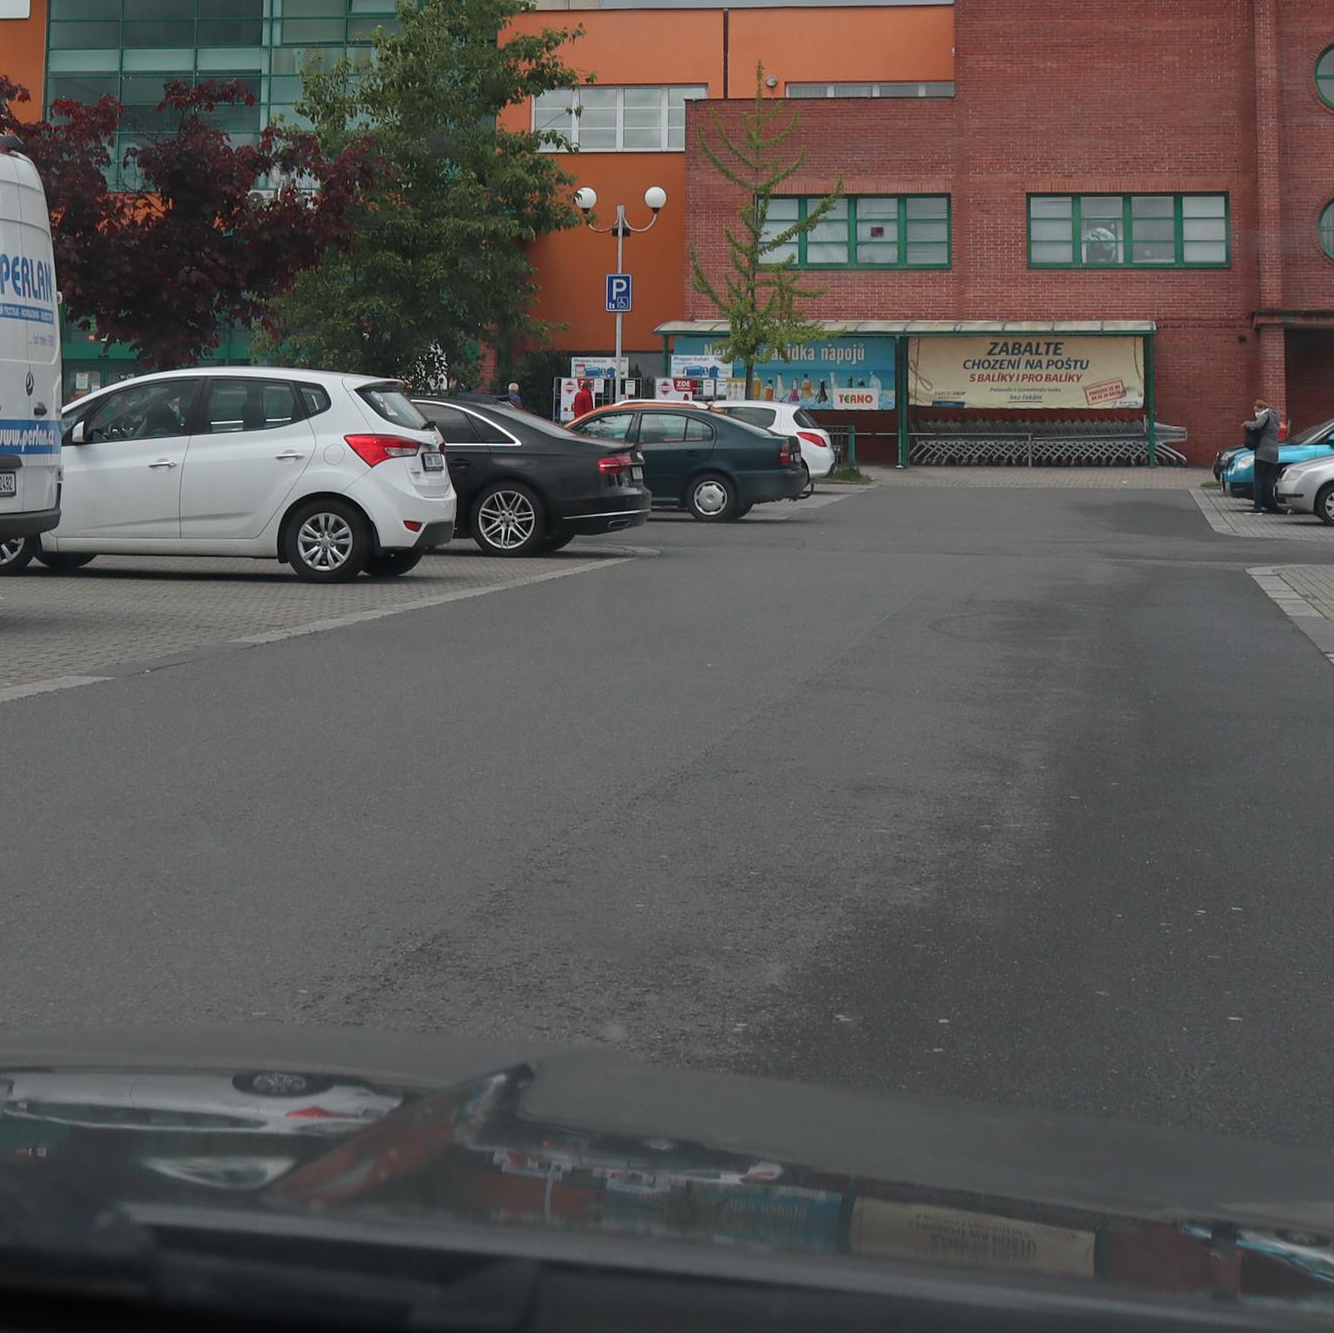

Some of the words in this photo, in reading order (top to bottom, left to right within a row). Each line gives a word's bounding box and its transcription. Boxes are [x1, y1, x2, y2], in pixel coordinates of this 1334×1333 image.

[0, 253, 53, 303] PERLAN
[612, 279, 627, 300] P
[820, 341, 865, 366] nápojů
[987, 341, 1064, 356] ZABALTE
[963, 357, 1022, 371] CHOZENÍ
[1025, 359, 1044, 370] NA
[1046, 358, 1089, 371] POŠTU
[676, 380, 691, 388] ZDE
[969, 373, 976, 383] S
[976, 372, 1016, 383] BALÍKY
[1021, 373, 1044, 383] PRO
[1044, 372, 1083, 383] BALÍKY
